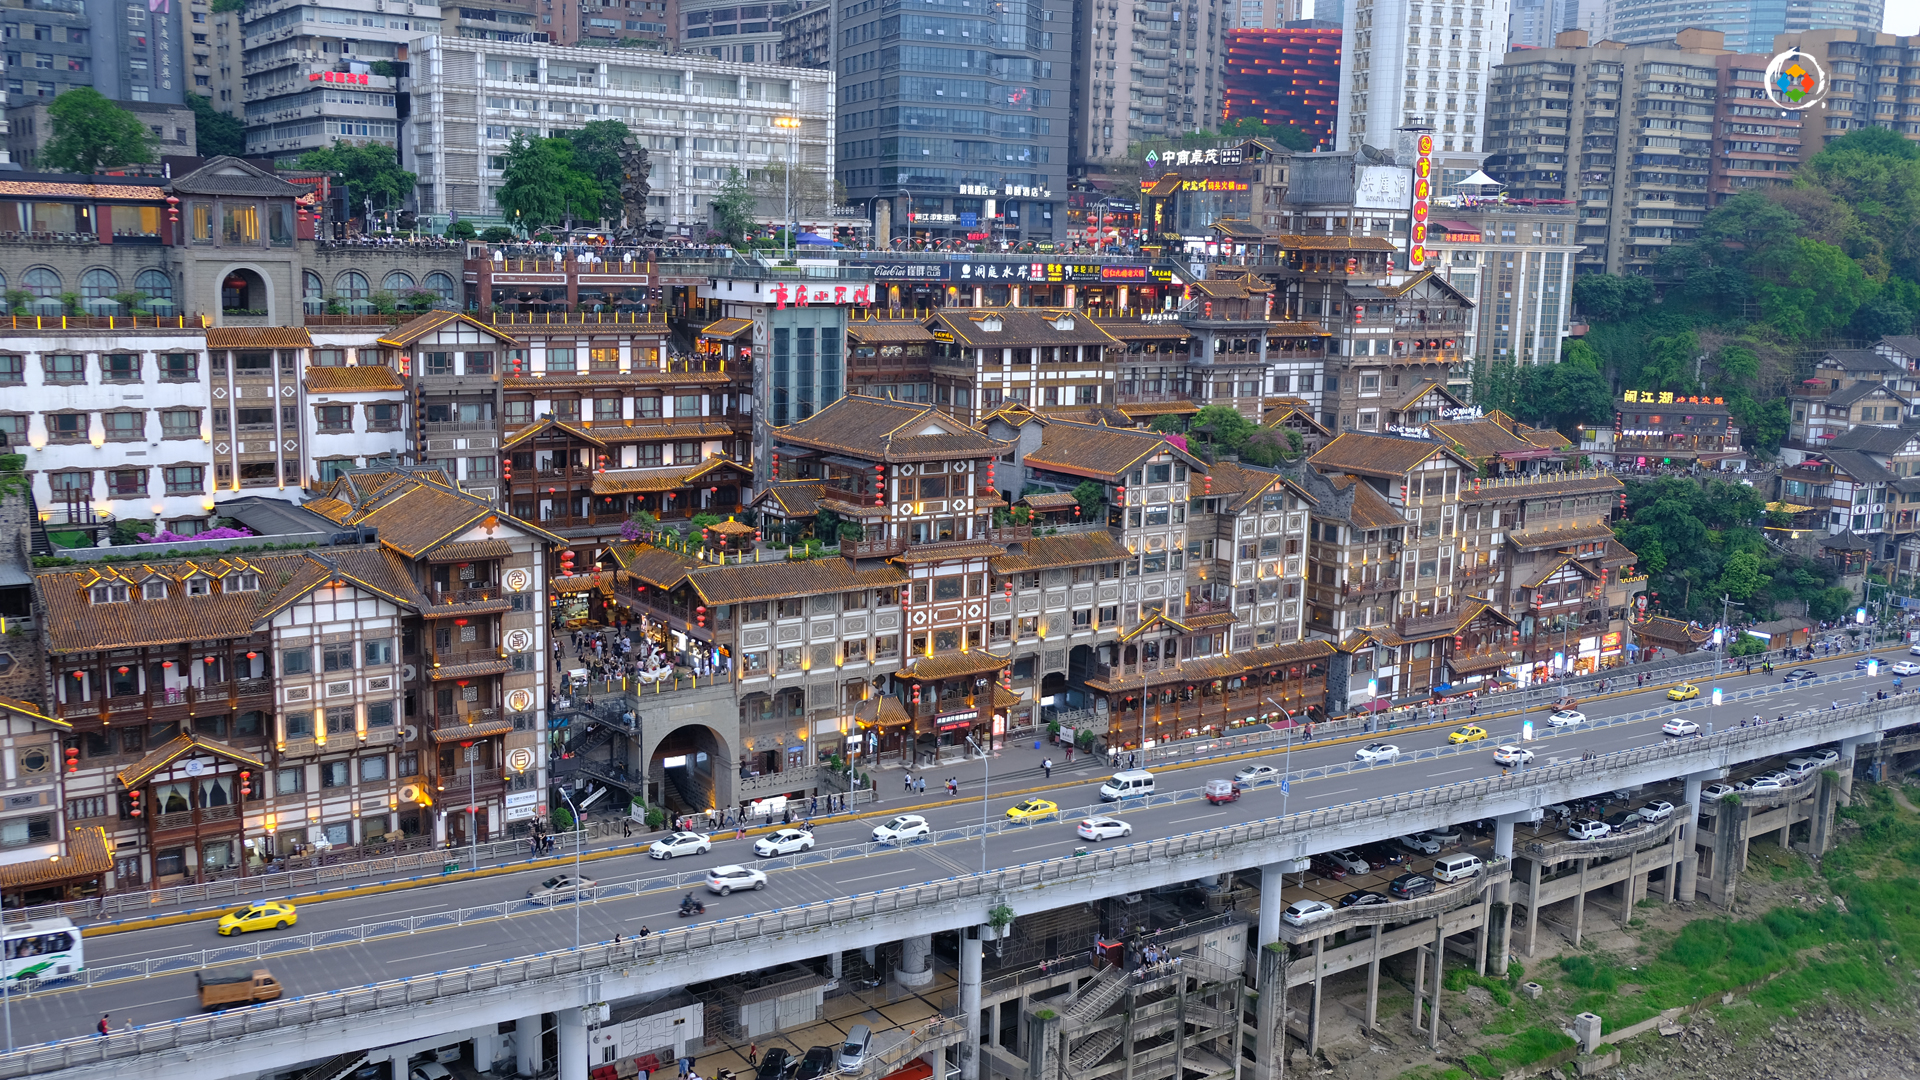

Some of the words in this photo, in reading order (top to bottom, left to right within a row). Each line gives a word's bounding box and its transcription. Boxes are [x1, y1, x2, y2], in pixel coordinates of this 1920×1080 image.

[1162, 149, 1218, 166] 中商卓茂
[1413, 158, 1429, 262] 重庆小天鹅
[974, 264, 1028, 279] 洞庭水岸
[770, 282, 871, 311] 重庆小天鹅
[1624, 389, 1674, 404] 闹江湖
